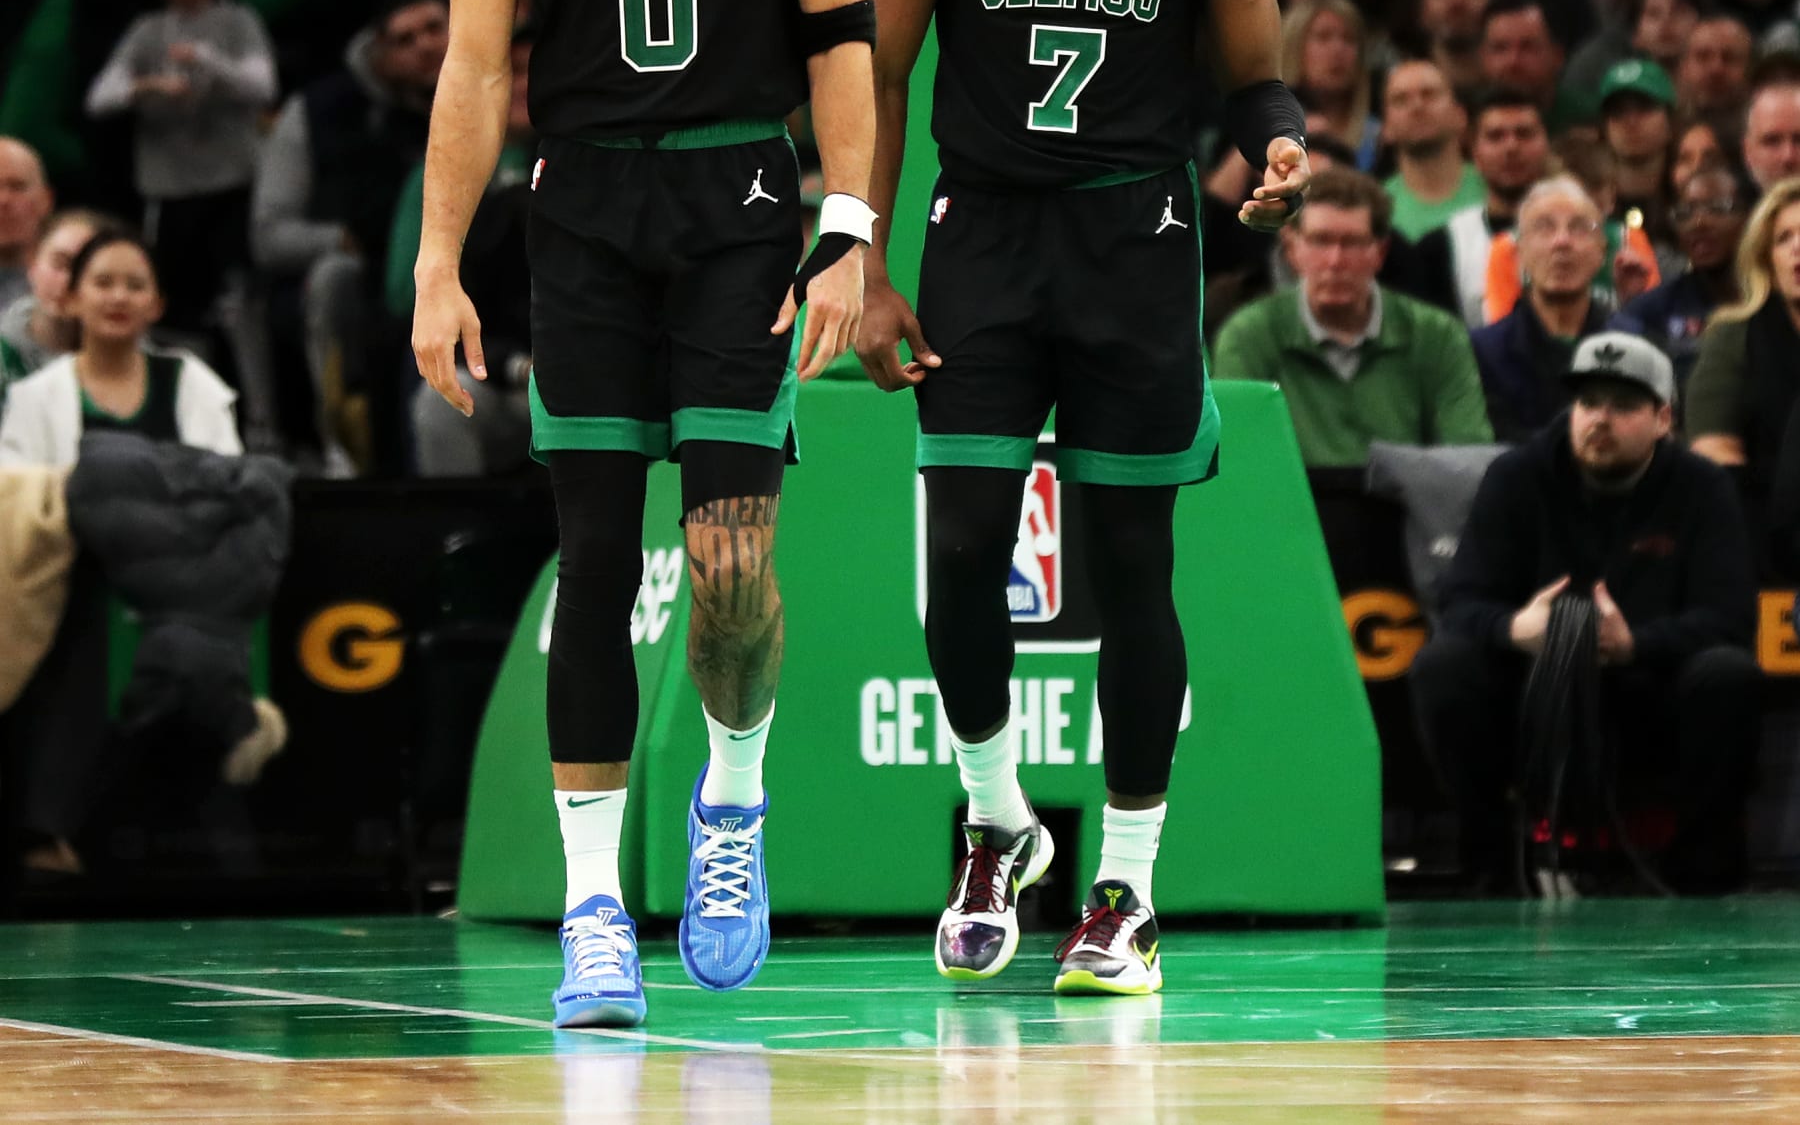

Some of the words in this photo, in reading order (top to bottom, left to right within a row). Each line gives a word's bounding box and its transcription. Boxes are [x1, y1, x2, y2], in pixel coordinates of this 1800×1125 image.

[1027, 24, 1107, 134] 7
[297, 600, 406, 693] G
[1340, 587, 1430, 682] G
[1008, 678, 1076, 765] HE
